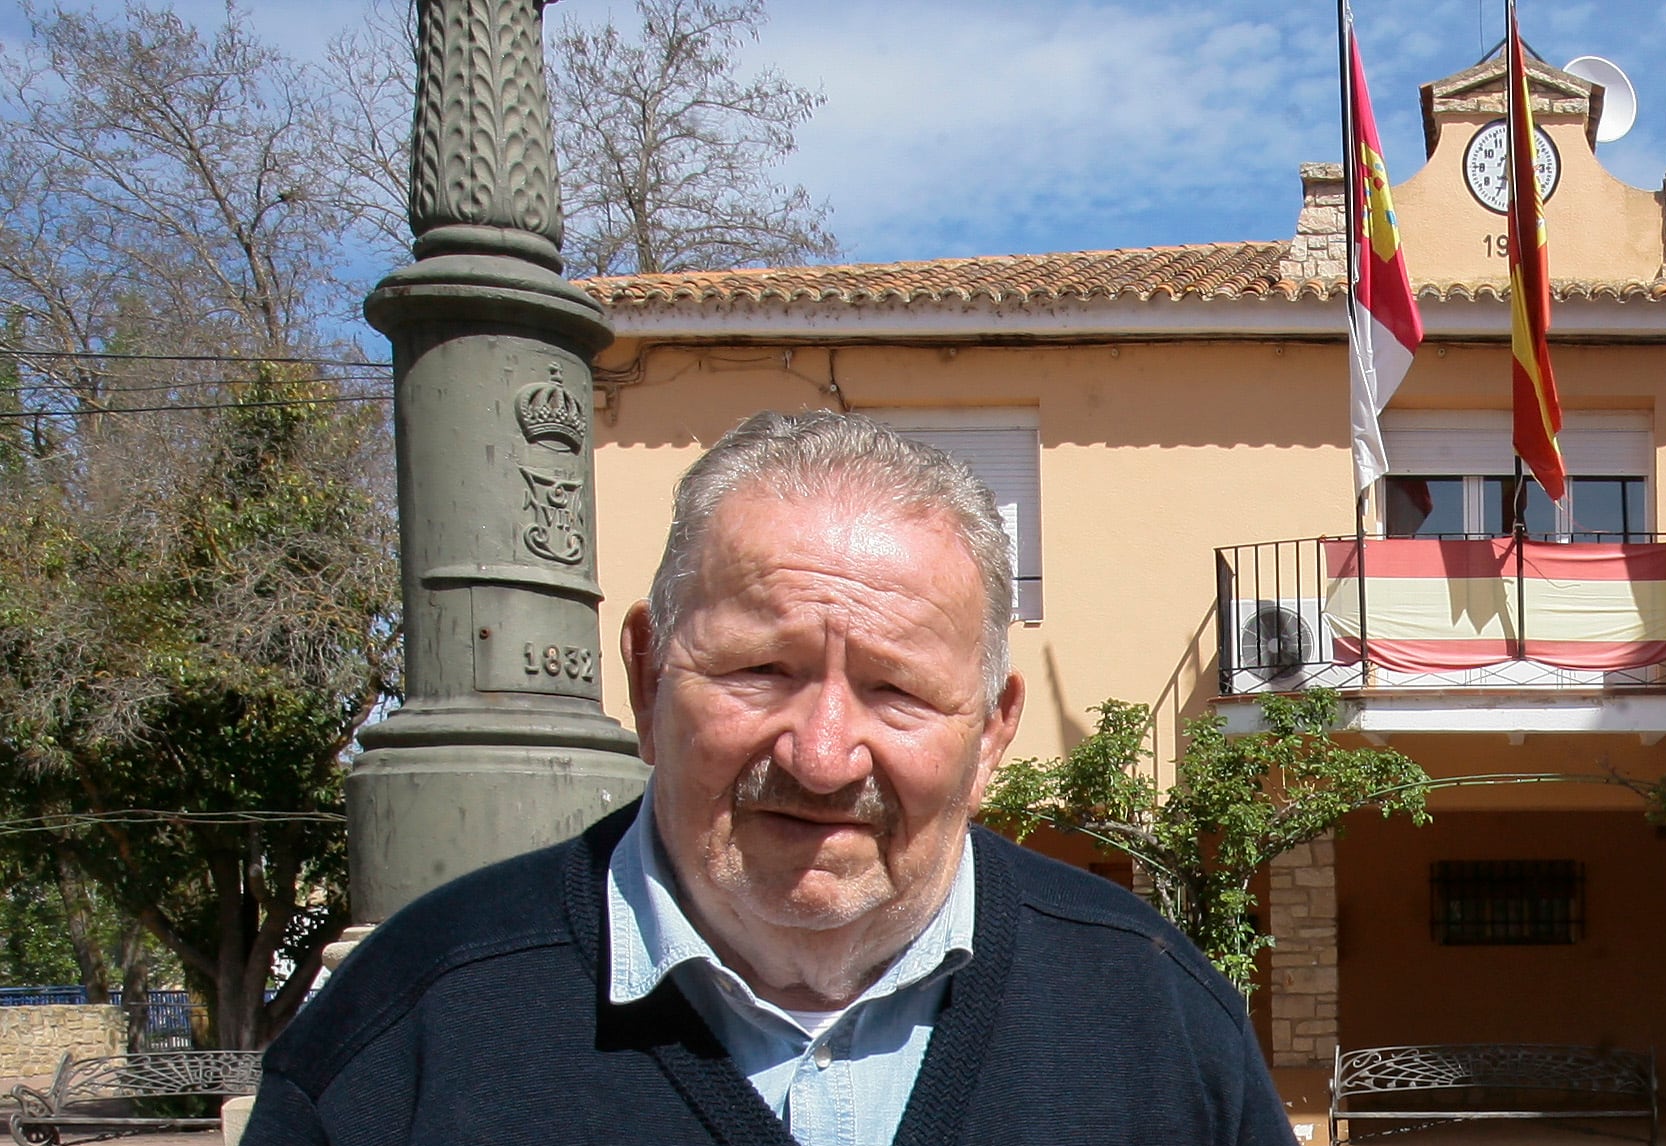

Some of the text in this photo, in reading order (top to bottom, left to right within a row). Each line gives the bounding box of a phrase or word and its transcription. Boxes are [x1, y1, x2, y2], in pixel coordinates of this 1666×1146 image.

[1484, 149, 1494, 159] 10
[1484, 176, 1490, 186] 8
[525, 640, 593, 682] 1832
